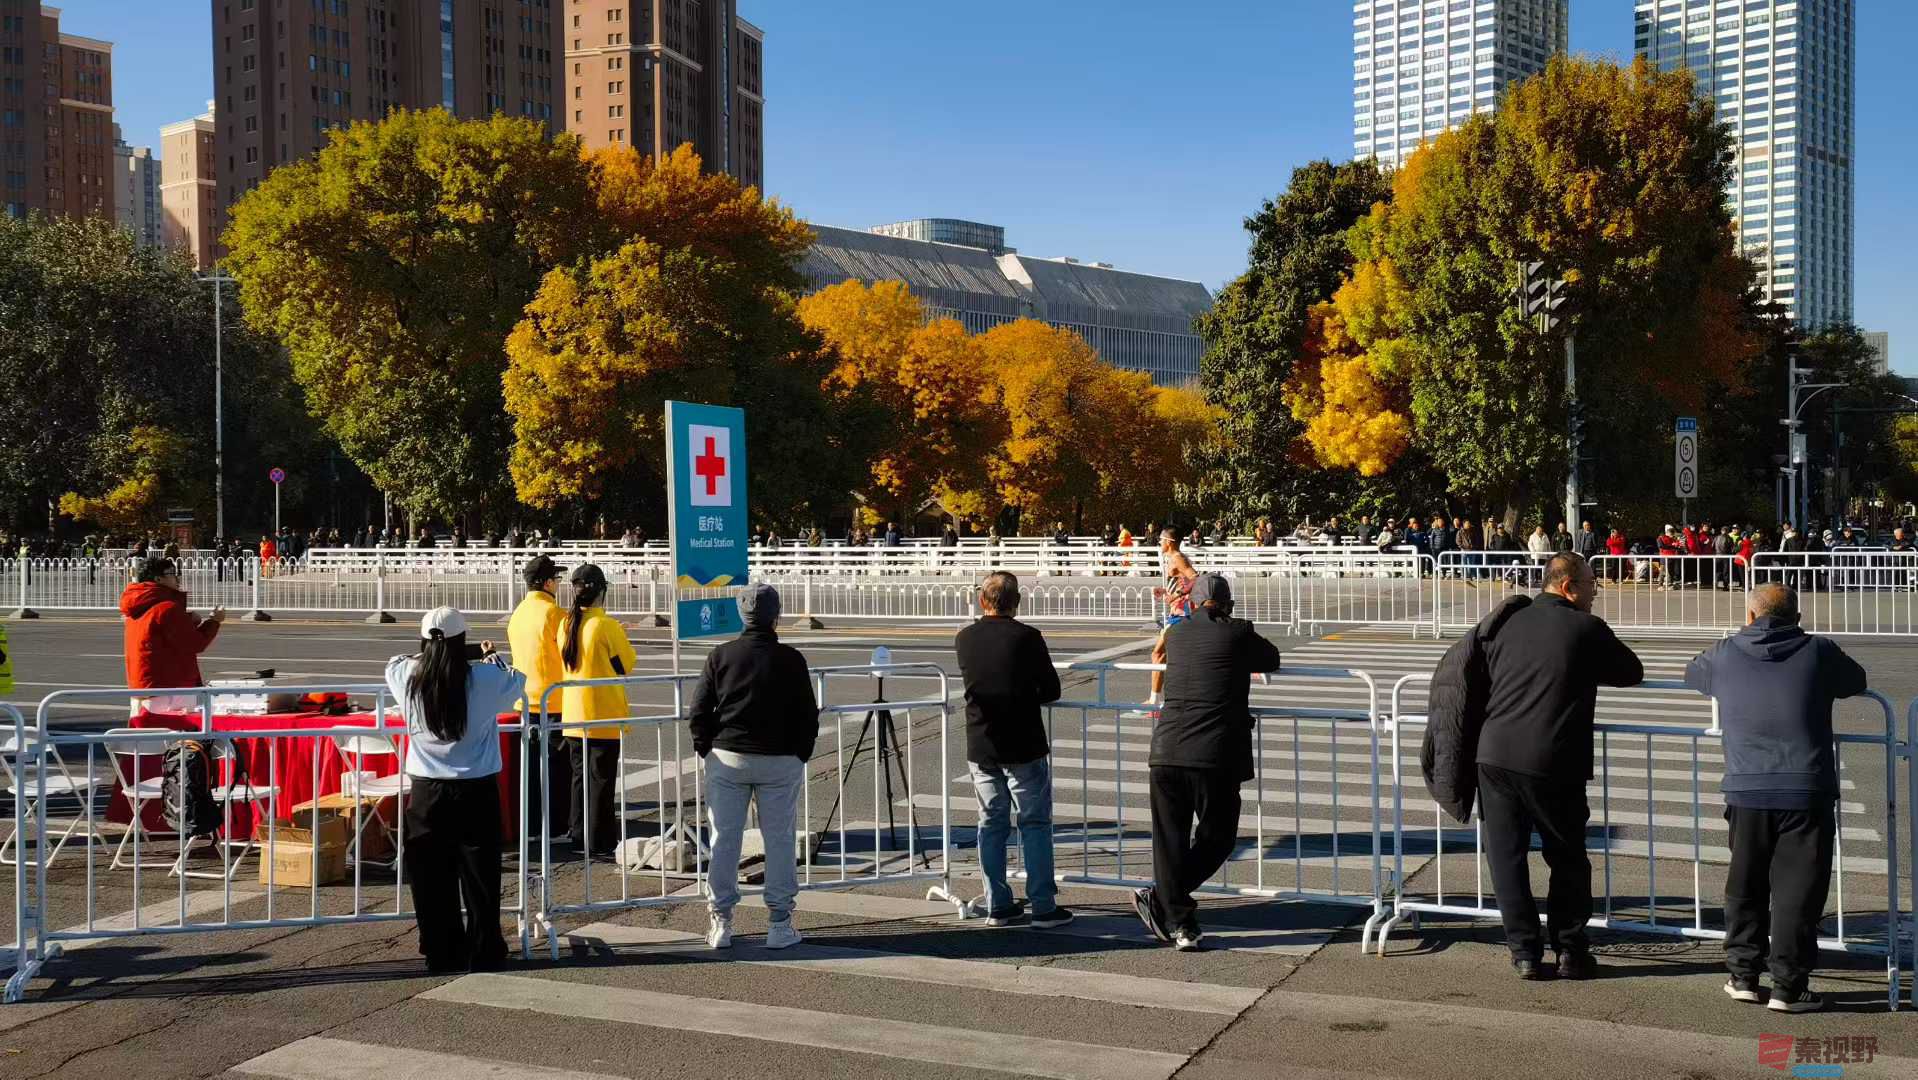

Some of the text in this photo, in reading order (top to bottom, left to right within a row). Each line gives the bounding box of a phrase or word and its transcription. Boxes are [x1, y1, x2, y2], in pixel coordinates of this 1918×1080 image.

[698, 515, 724, 532] 医疗站
[690, 537, 735, 548] Medical Station
